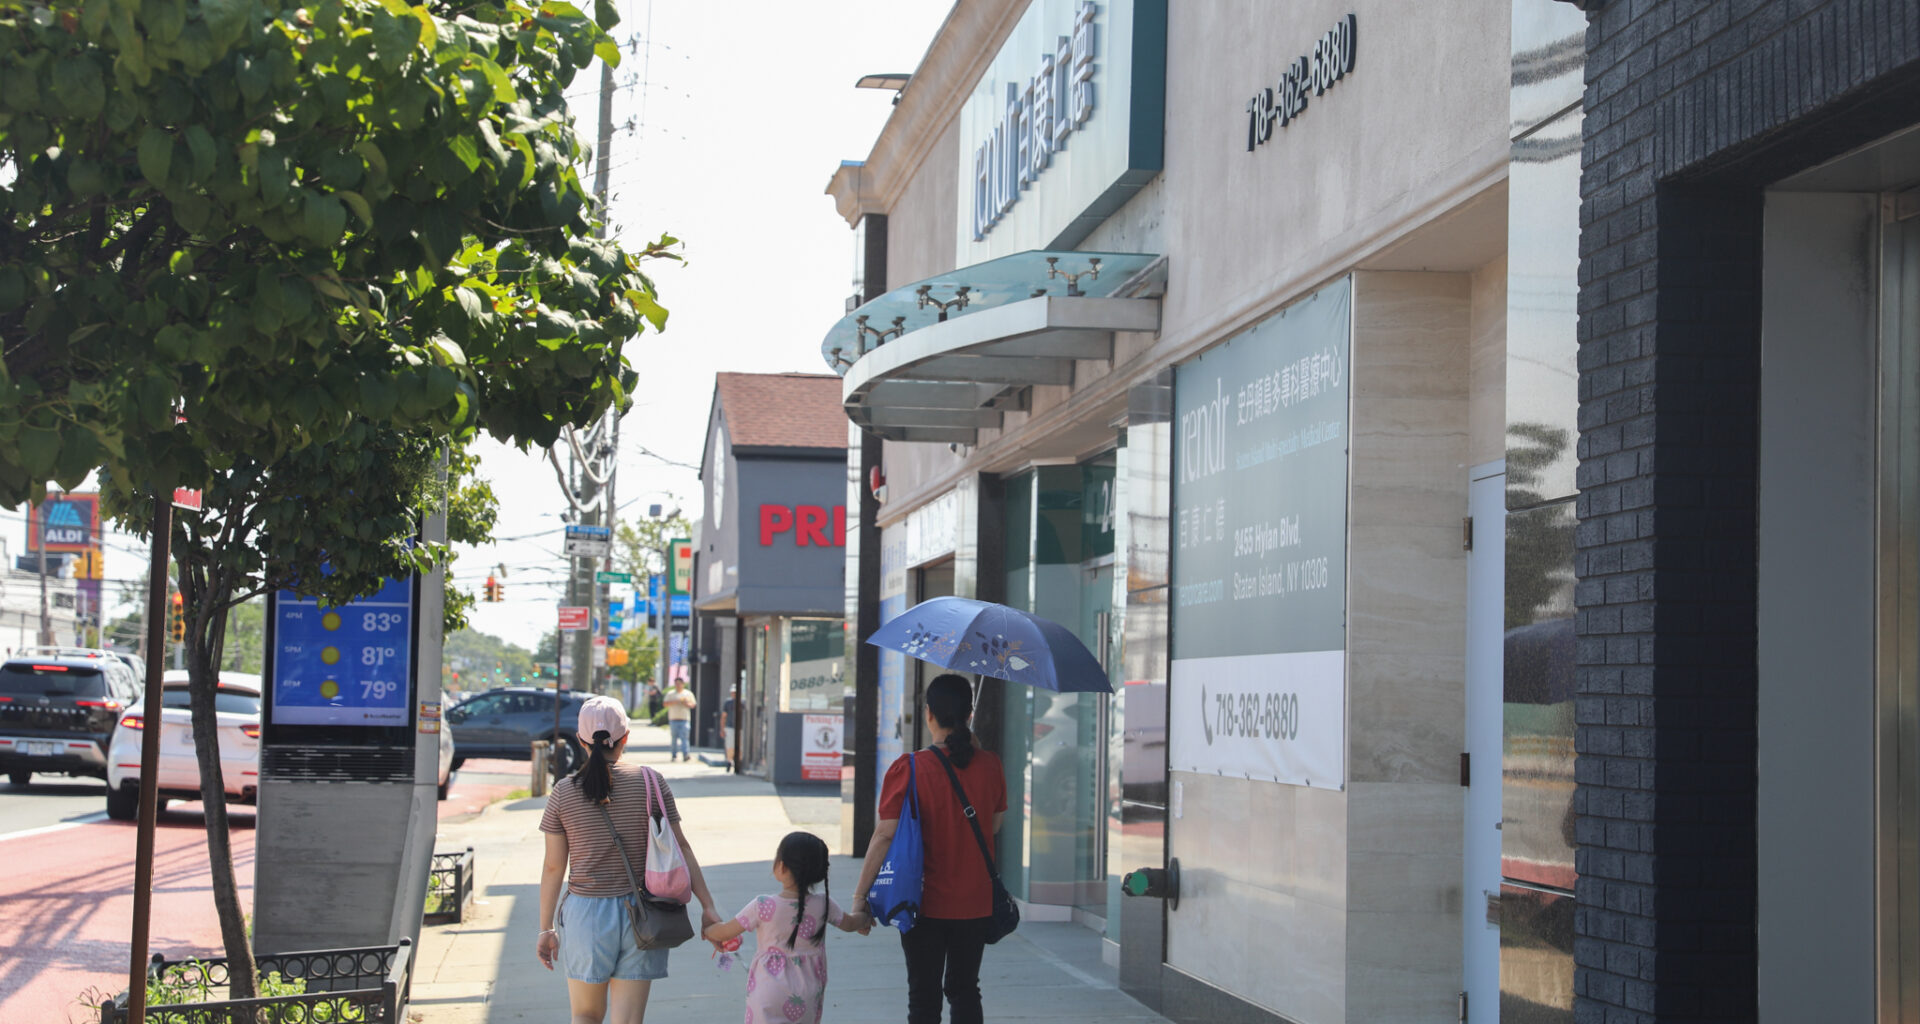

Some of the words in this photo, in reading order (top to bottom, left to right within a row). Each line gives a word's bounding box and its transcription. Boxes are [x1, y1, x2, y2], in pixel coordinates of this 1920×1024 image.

[1246, 14, 1357, 152] 718-362-6880
[1182, 377, 1229, 485] rendr
[46, 528, 82, 543] ALDI
[760, 504, 846, 547] PRI
[1234, 526, 1253, 557] 2455
[1255, 521, 1278, 559] Hylan
[1280, 514, 1301, 549] Blvd,
[1234, 571, 1257, 600] Staten
[1258, 563, 1285, 598] Island,
[1287, 561, 1300, 593] NY
[1301, 556, 1328, 591] 10306
[285, 612, 303, 620] 4PM
[362, 612, 402, 632] 83°
[284, 645, 302, 653] 5PM
[361, 646, 396, 666] 81°
[360, 680, 398, 700] 79°
[1216, 692, 1298, 741] 718-362-6880
